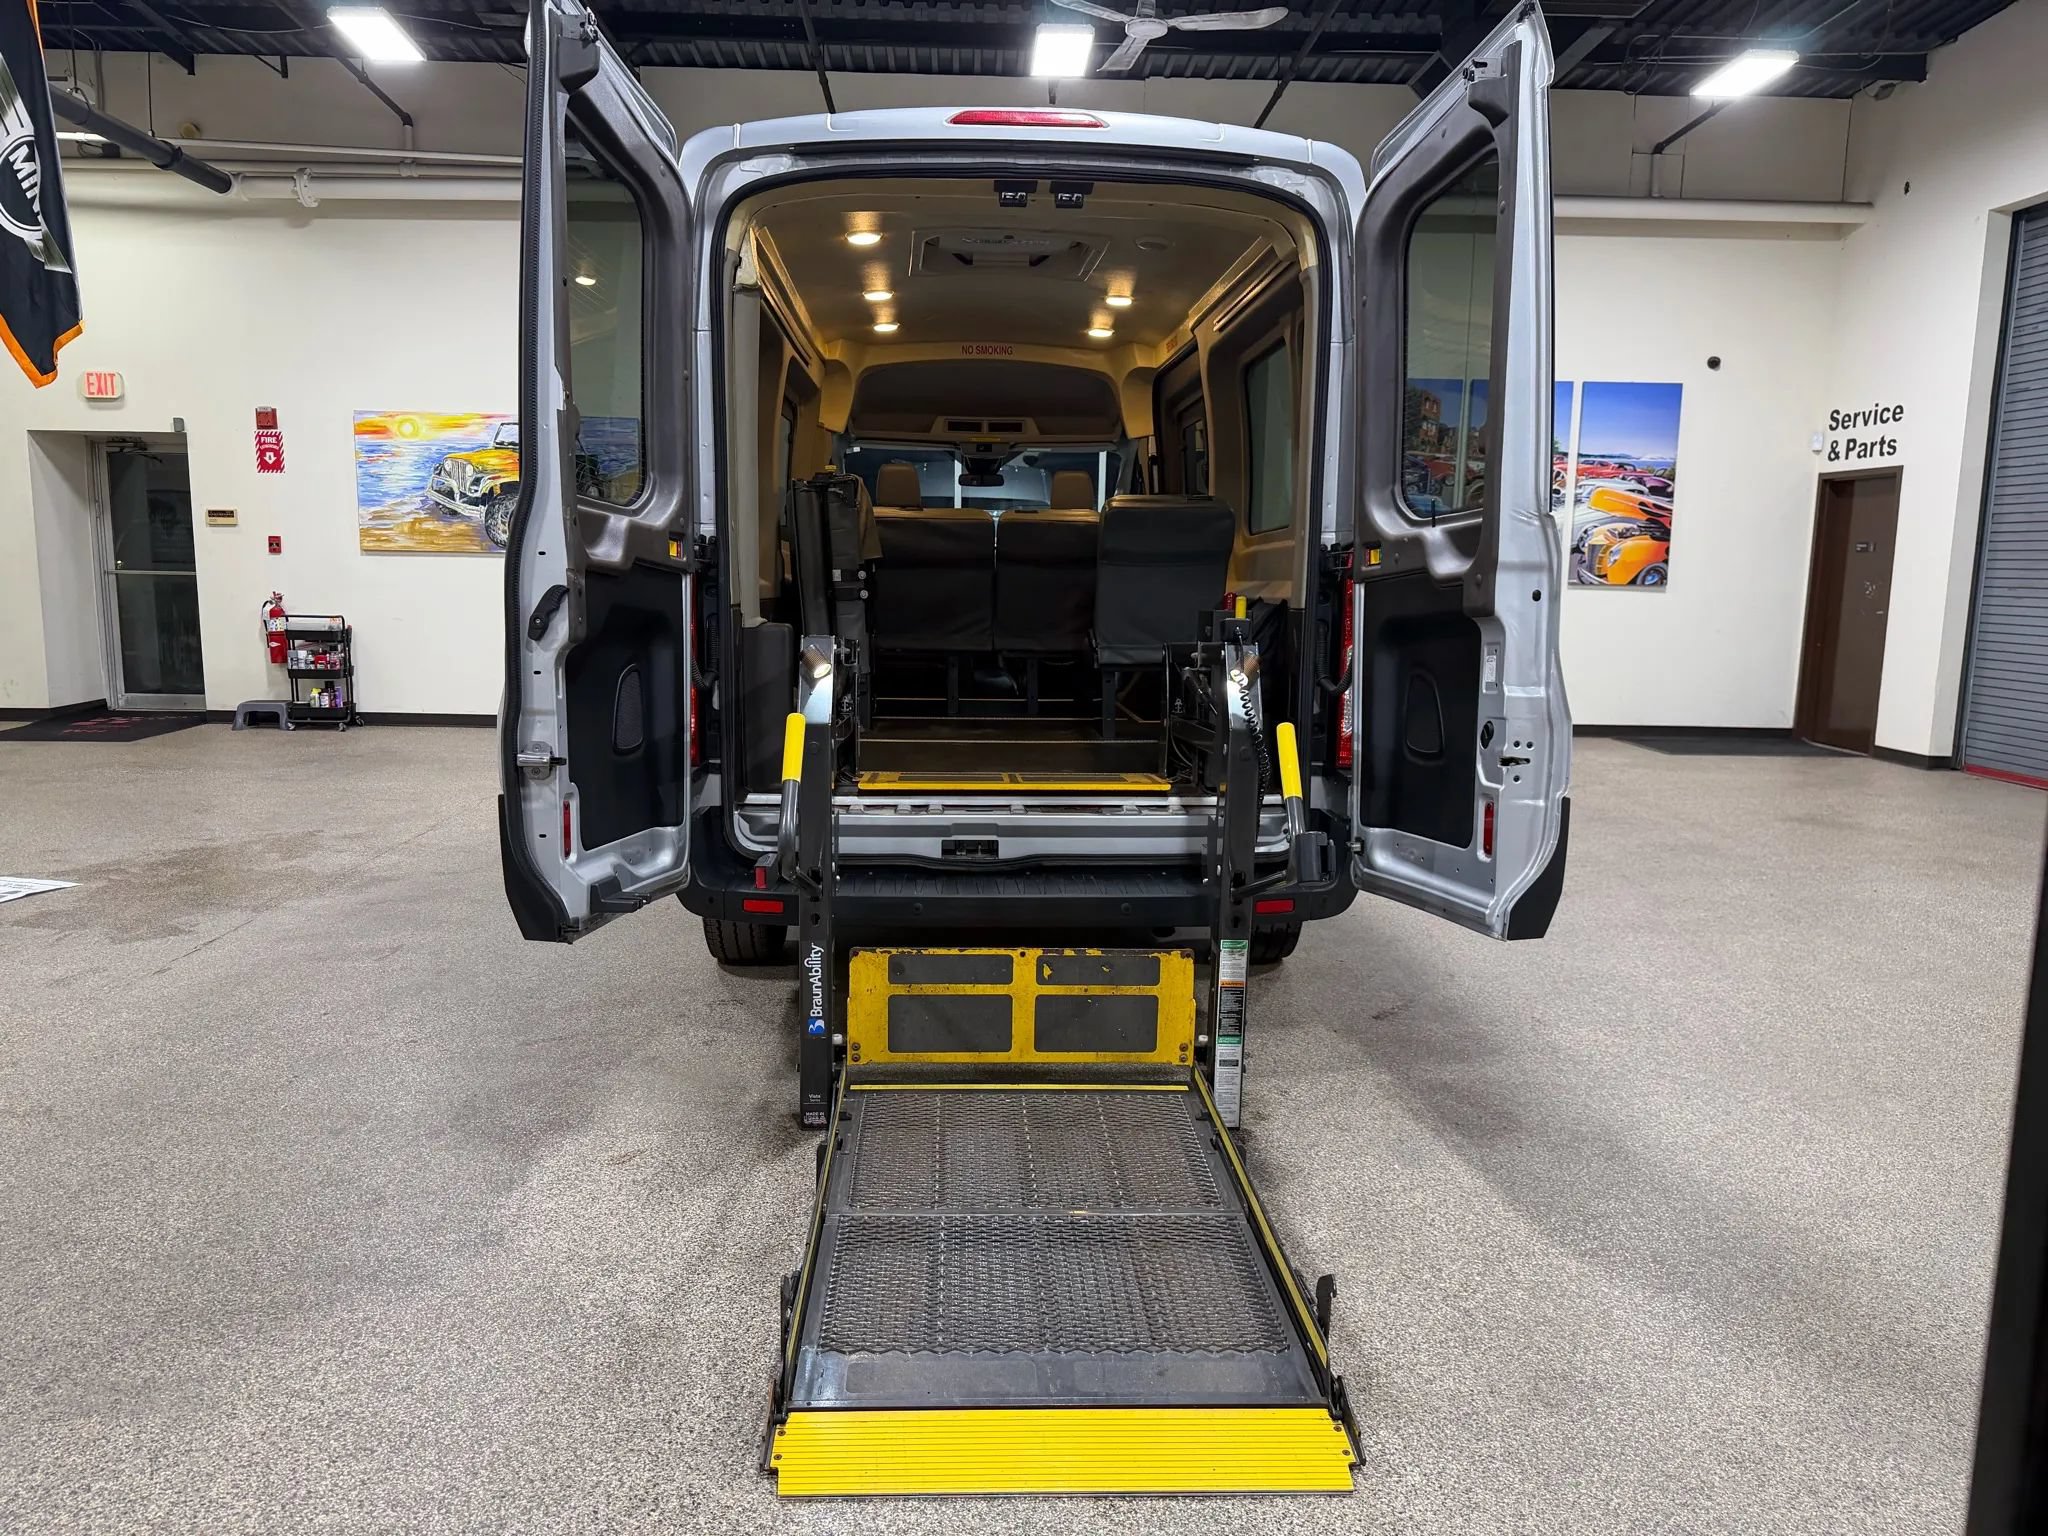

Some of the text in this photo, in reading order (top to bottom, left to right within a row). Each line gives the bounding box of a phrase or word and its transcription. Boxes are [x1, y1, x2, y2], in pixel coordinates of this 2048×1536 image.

[961, 344, 1013, 356] NO SMOKING
[86, 372, 116, 396] EXIT
[1828, 403, 1904, 431] Service
[261, 436, 278, 444] FIRE
[1827, 435, 1897, 462] & Parts
[804, 943, 824, 1017] BraunAbility
